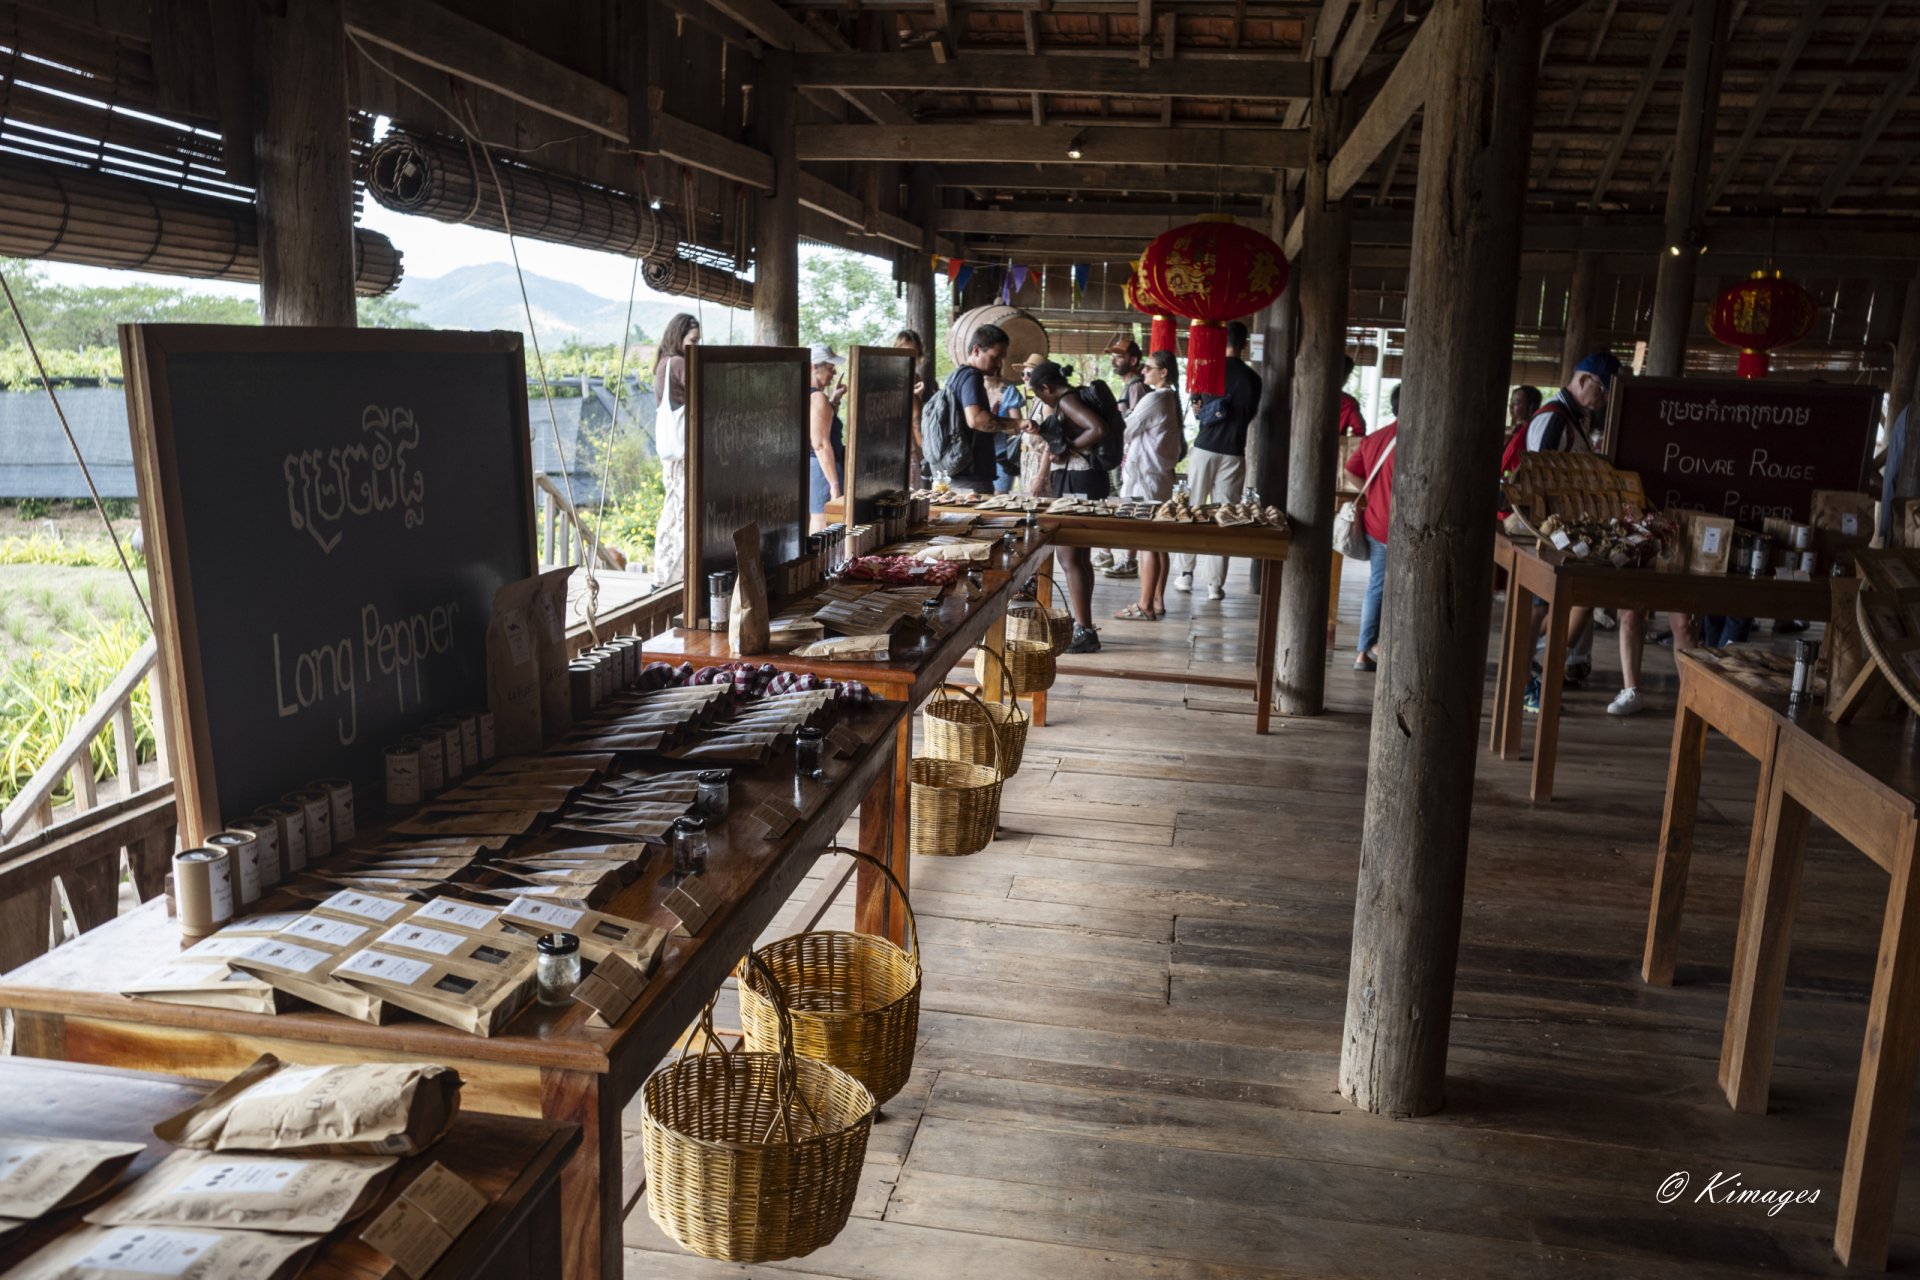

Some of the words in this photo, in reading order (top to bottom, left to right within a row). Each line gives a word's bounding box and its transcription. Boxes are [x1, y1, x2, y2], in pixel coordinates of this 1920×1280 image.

[1663, 442, 1736, 476] POIVRE
[1749, 448, 1816, 480] ROUGE
[1723, 490, 1793, 522] PEPPER
[273, 632, 357, 746] Long
[361, 601, 459, 713] Pepper
